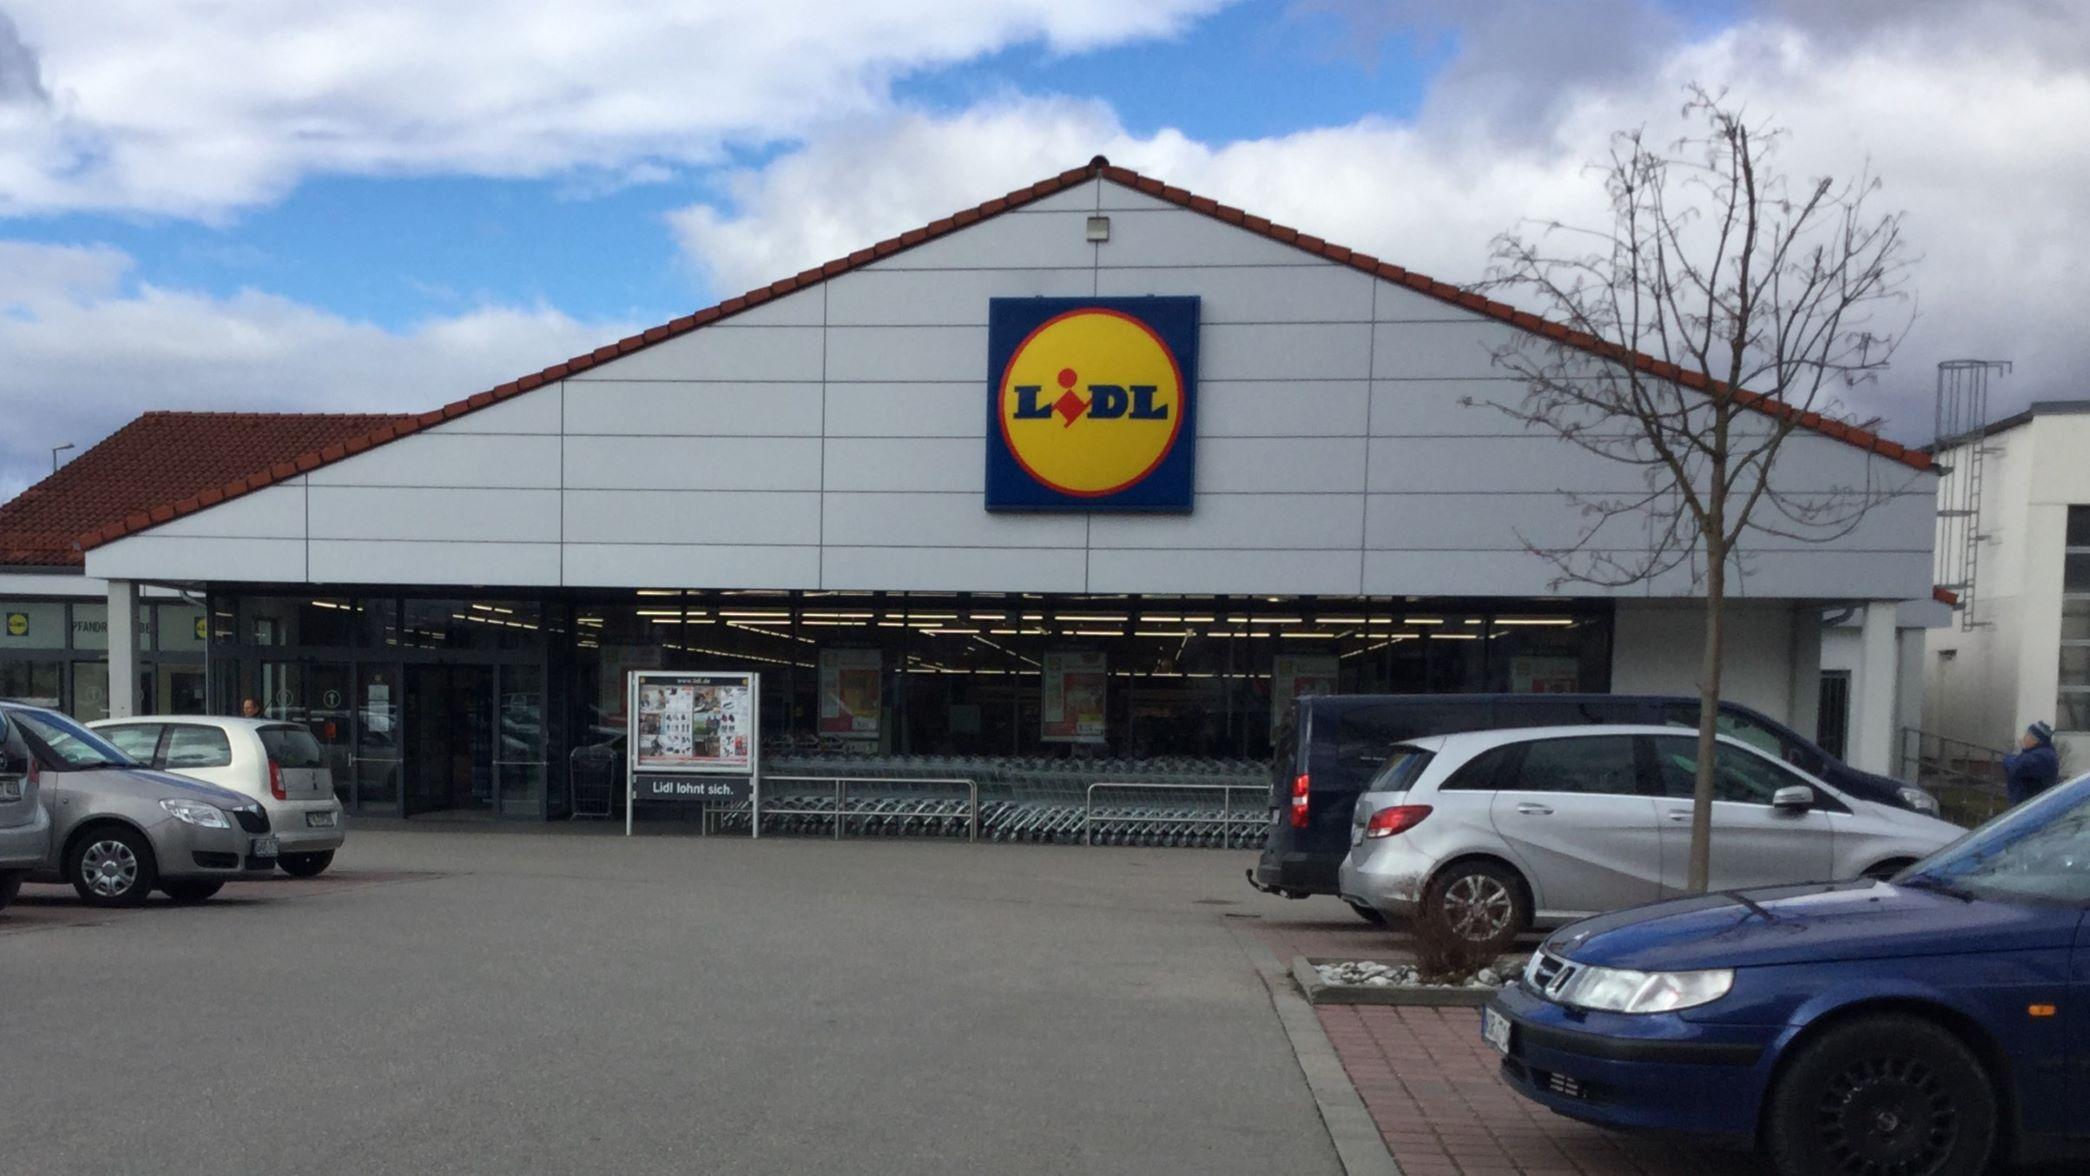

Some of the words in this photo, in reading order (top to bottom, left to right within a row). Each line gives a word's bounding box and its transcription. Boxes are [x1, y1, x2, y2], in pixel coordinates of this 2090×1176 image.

[652, 781, 674, 793] Lidl
[676, 782, 705, 795] lohnt
[707, 783, 734, 796] sich.
